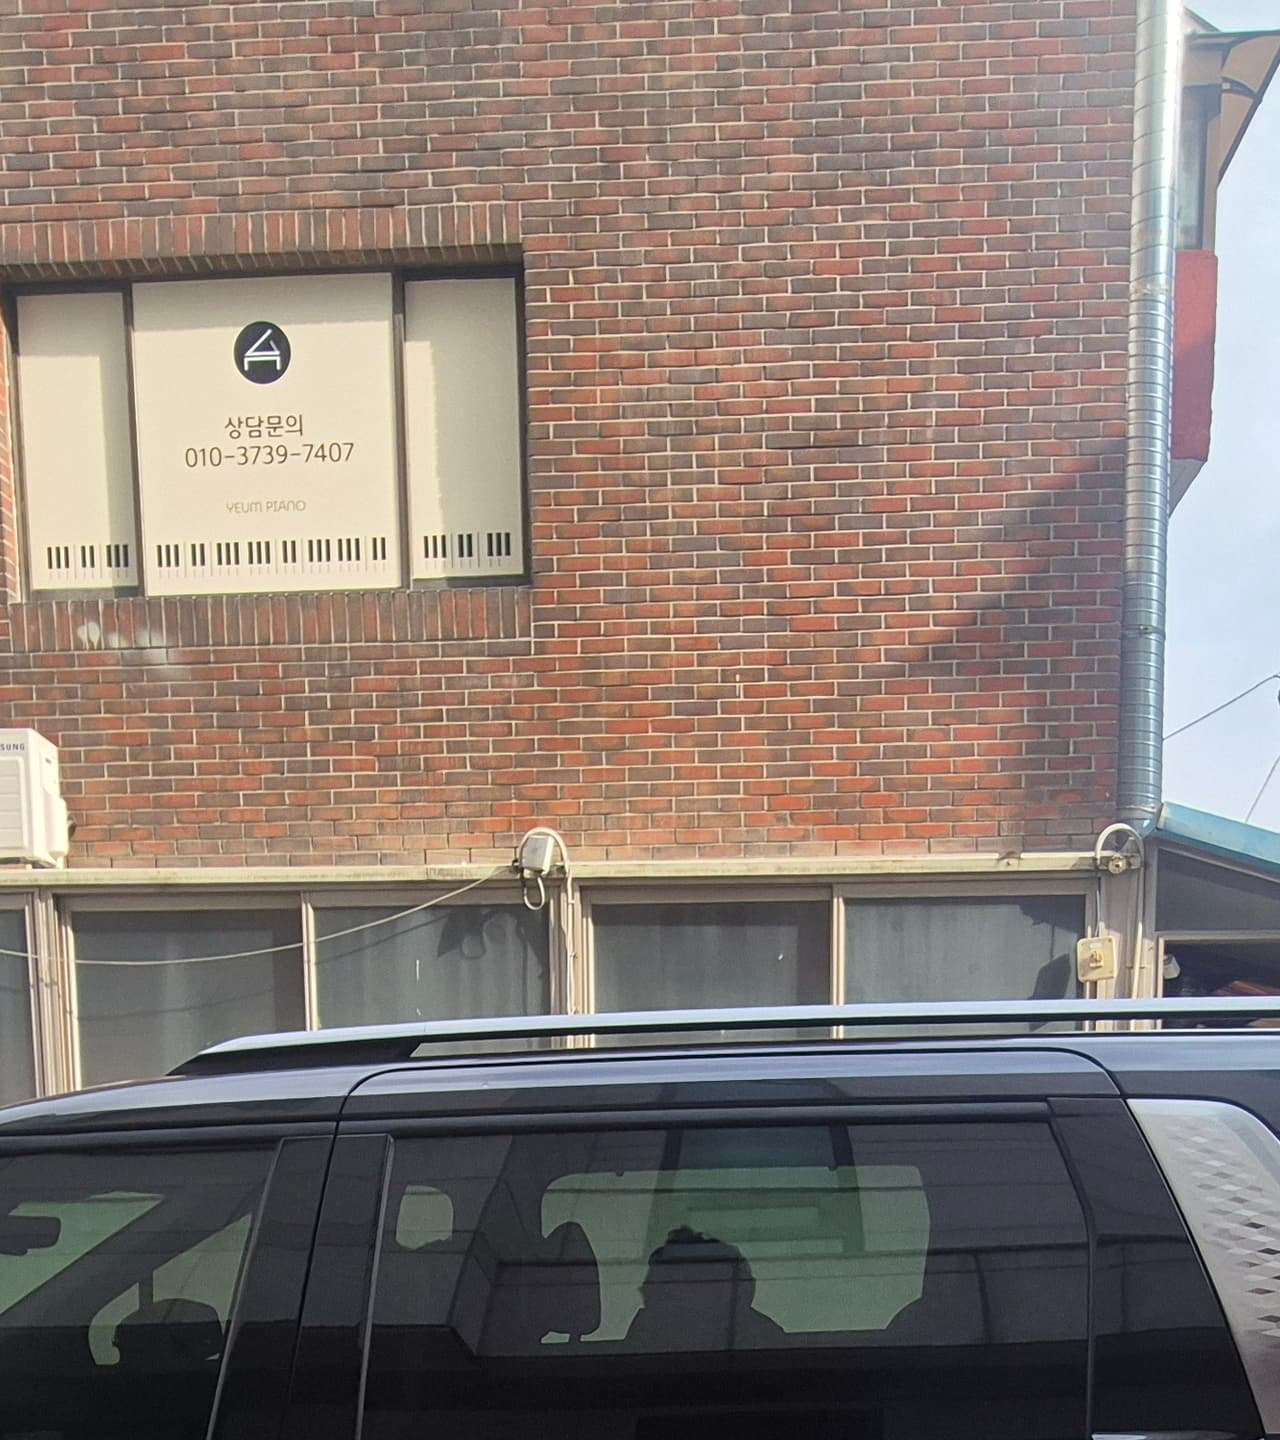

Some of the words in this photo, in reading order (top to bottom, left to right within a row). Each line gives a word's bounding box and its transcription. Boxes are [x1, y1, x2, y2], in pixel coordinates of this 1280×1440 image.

[224, 414, 304, 440] 상담문의
[184, 442, 355, 468] 010-3739-7407
[226, 501, 263, 514] YEUM
[266, 499, 307, 512] PIANO
